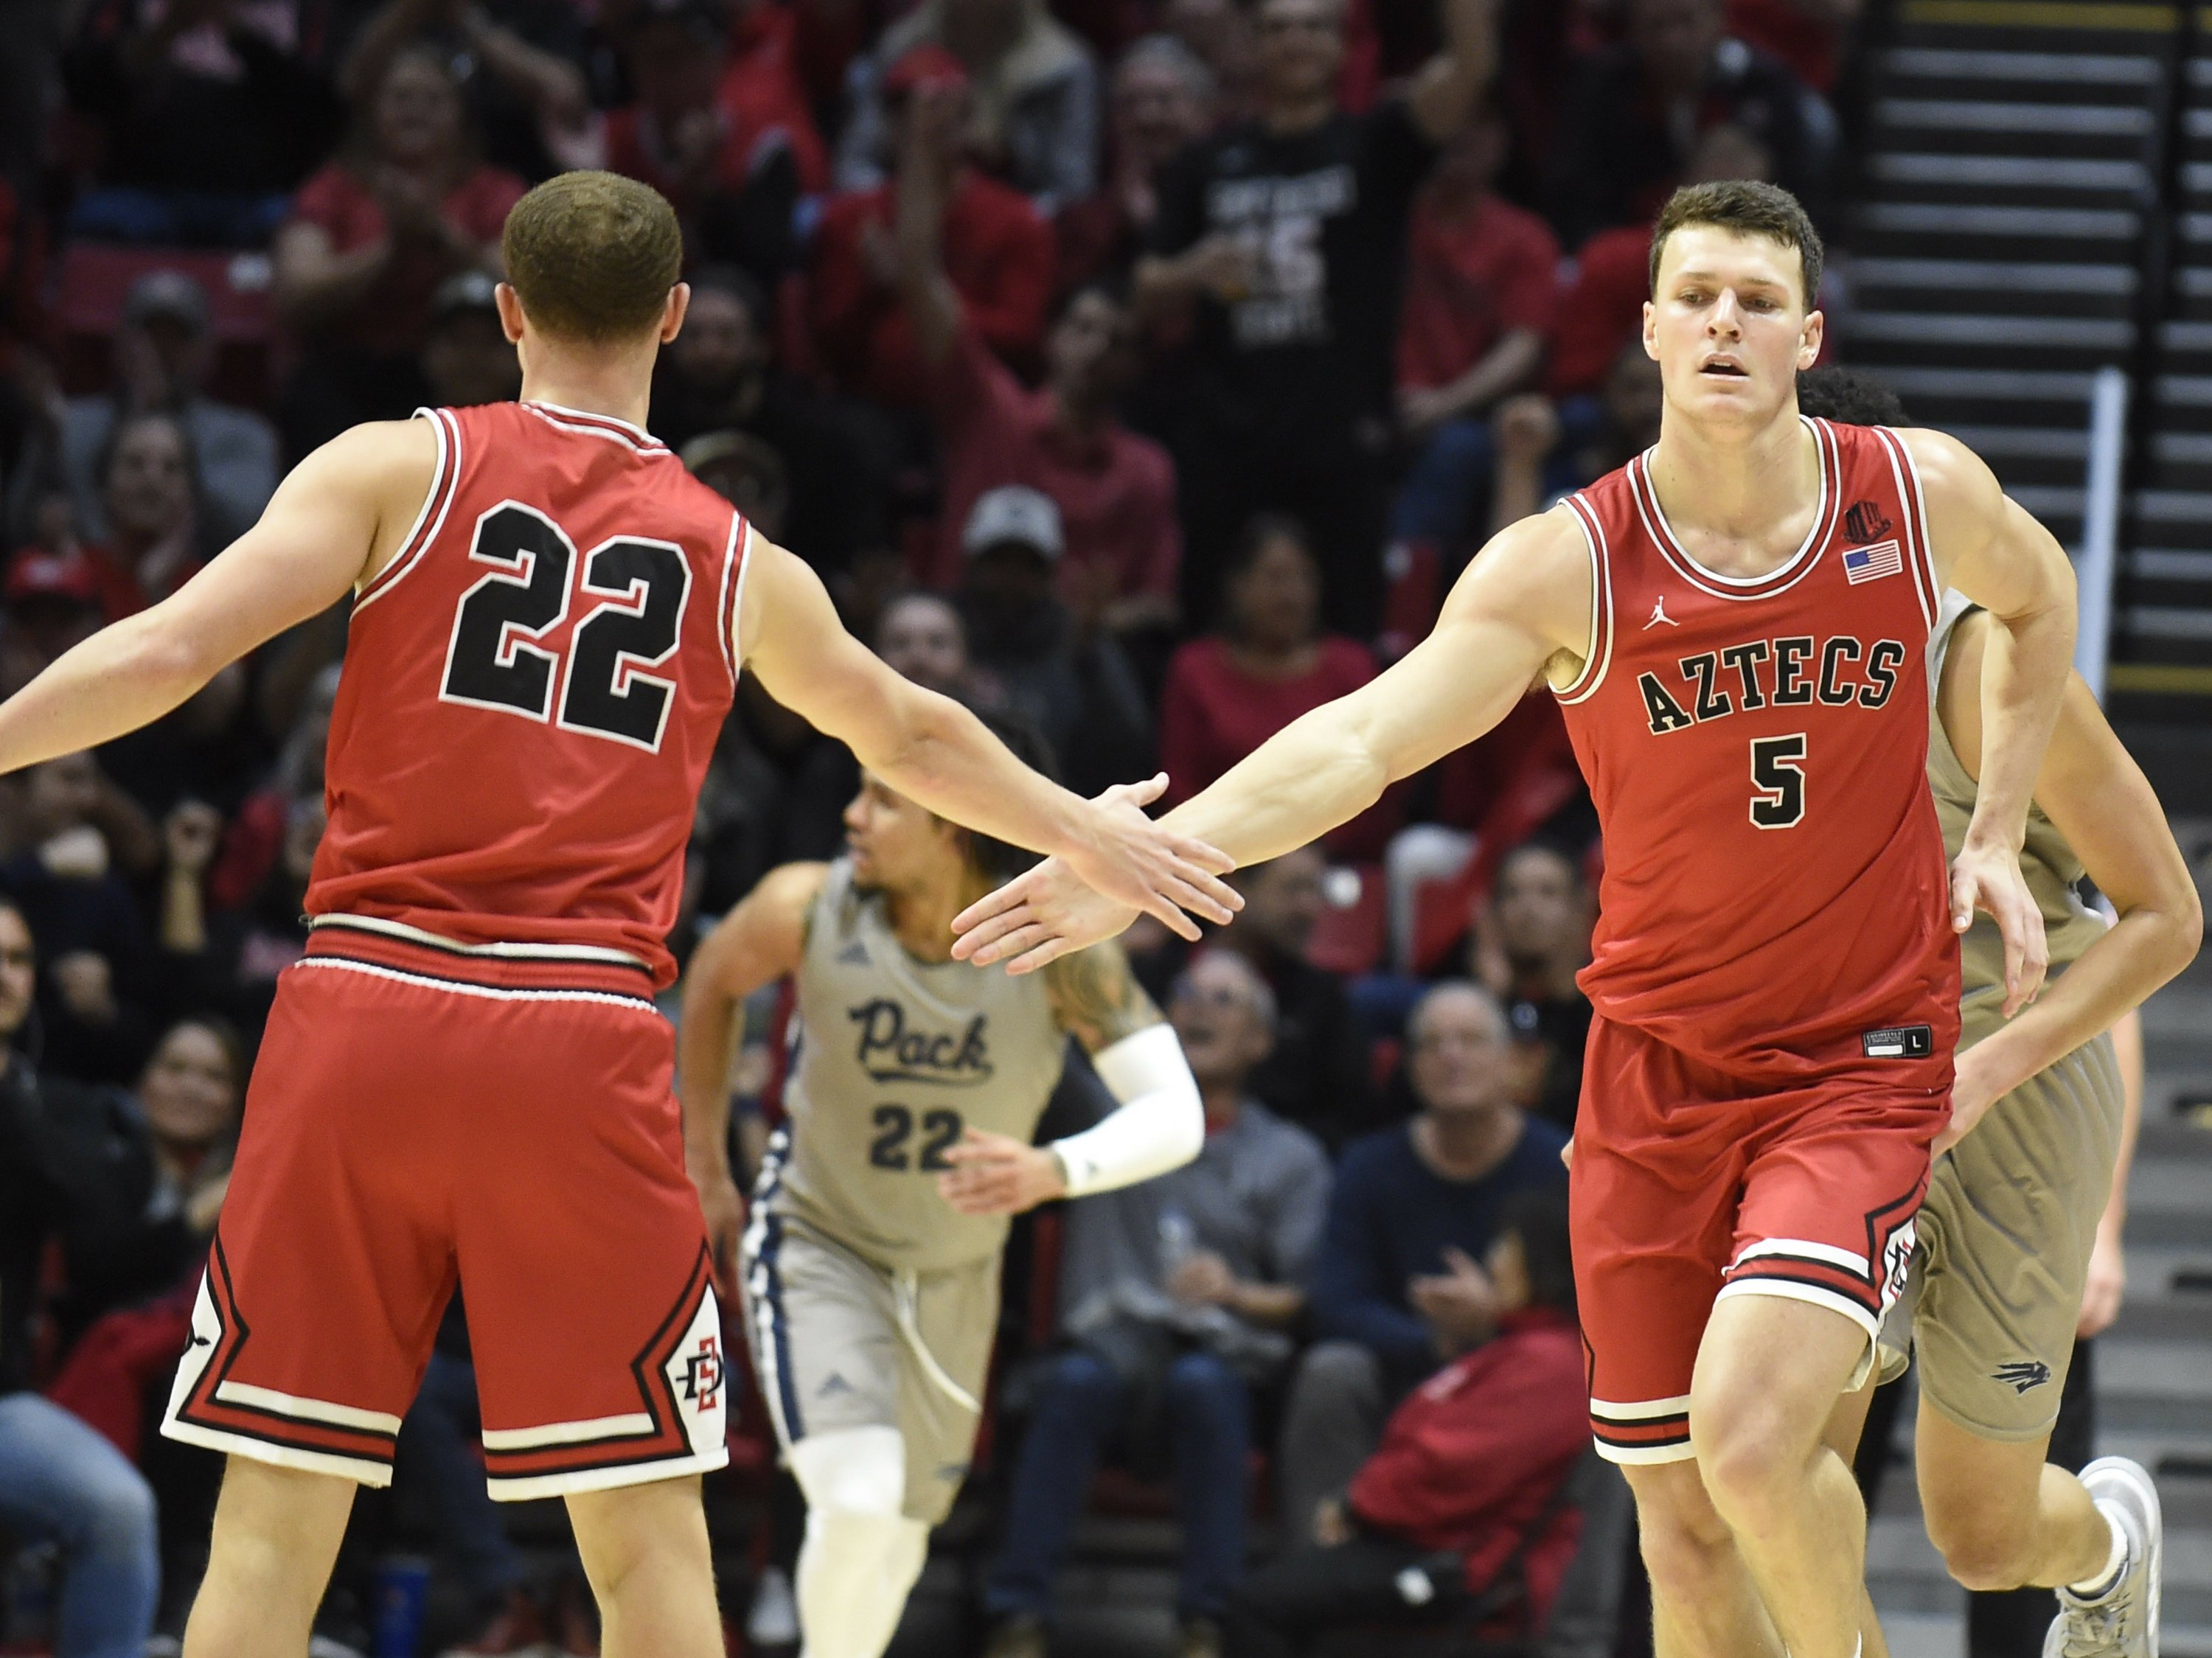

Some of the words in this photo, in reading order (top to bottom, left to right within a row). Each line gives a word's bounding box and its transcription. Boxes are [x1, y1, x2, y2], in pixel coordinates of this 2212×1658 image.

[438, 498, 693, 755] 22
[1637, 635, 1905, 736] AZTECS
[1749, 732, 1806, 829] 5
[849, 997, 994, 1087] Pack
[1912, 1034, 1922, 1048] L
[870, 1103, 964, 1172] 22
